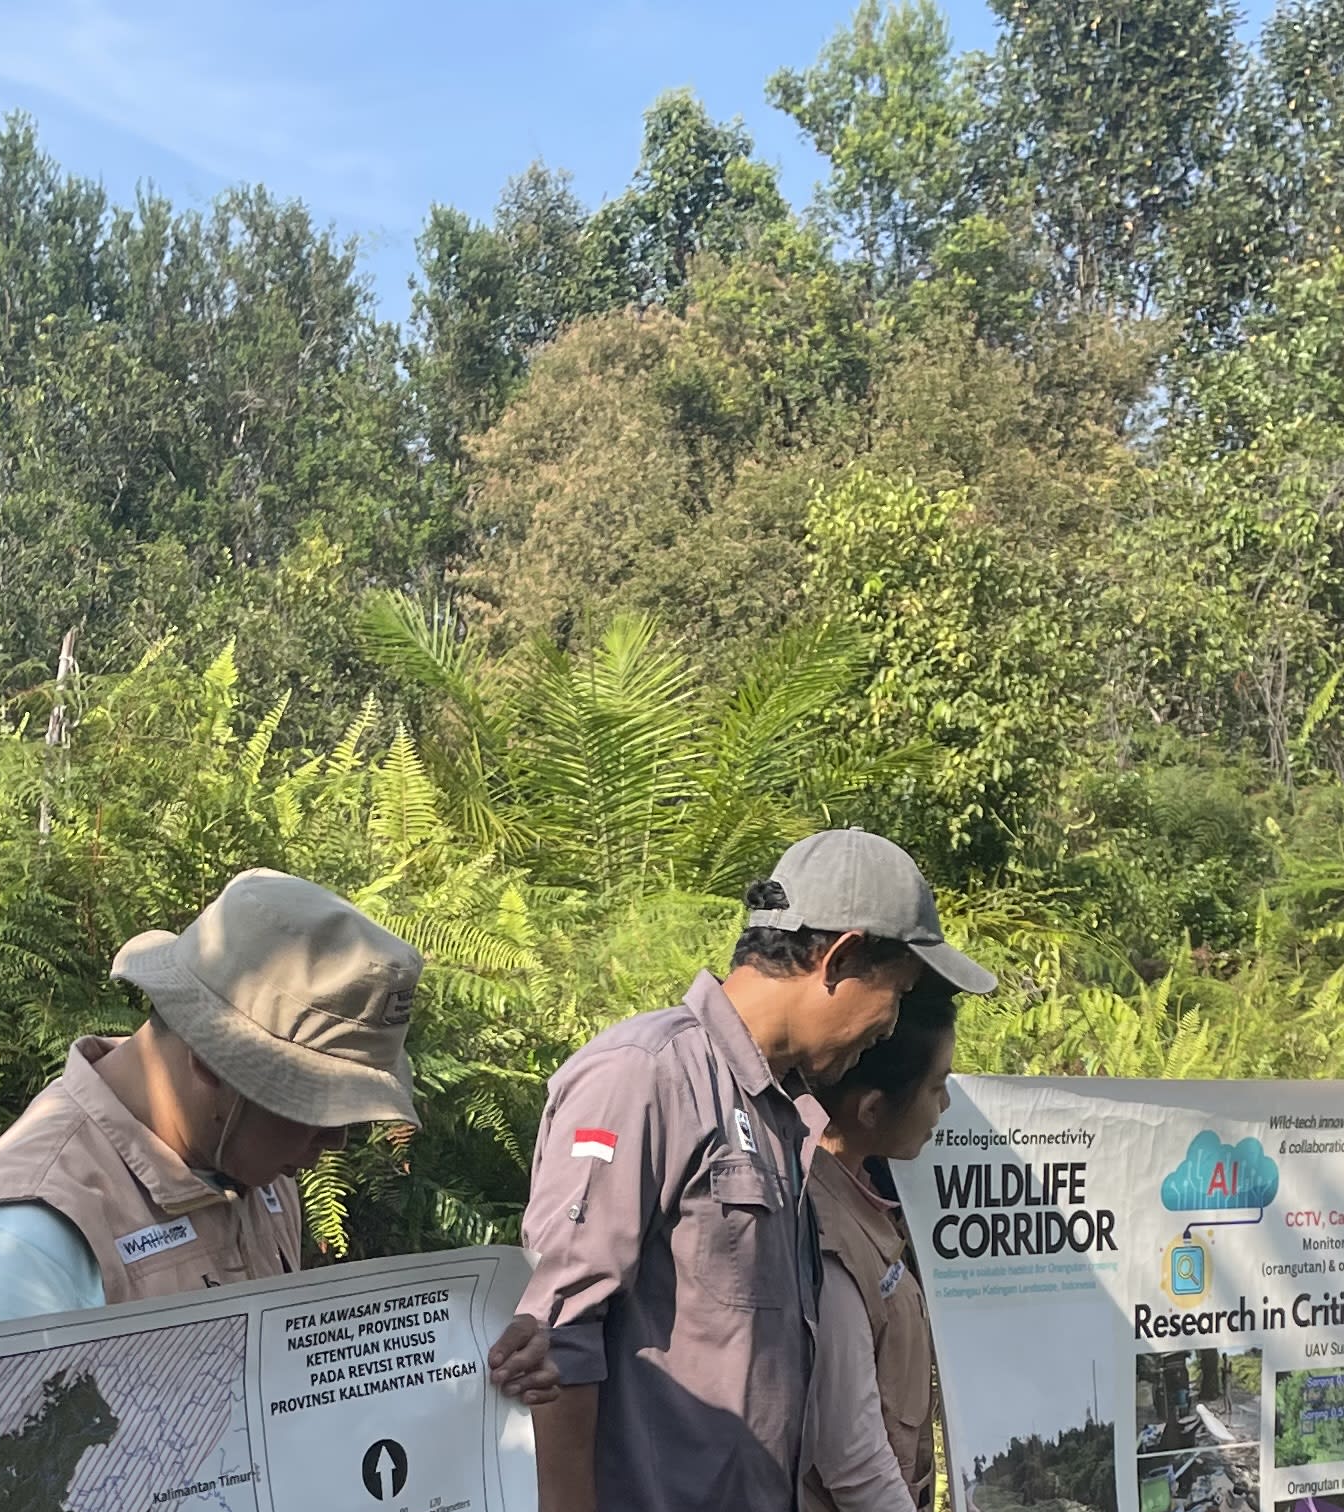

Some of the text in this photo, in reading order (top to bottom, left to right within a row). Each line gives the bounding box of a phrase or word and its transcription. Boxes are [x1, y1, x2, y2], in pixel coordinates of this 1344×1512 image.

[934, 1128, 1096, 1150] #EcologicalConnectivity
[1269, 1115, 1316, 1130] Wild-tech
[1279, 1141, 1287, 1155] &
[933, 1162, 1087, 1209] WILDLIFE
[1207, 1160, 1240, 1196] AI
[932, 1210, 1118, 1259] CORRIDOR
[1285, 1210, 1325, 1229] CCTV,
[1262, 1259, 1326, 1278] (orangutan)
[1329, 1259, 1336, 1272] &
[286, 1289, 449, 1332] PETA KAWASAN STRATEGIS
[1135, 1296, 1256, 1340] Research
[1262, 1296, 1285, 1330] in
[287, 1308, 449, 1351] NASIONAL, PROVINSI DAN
[306, 1330, 436, 1367] KETENTUAN KHUSUS
[1305, 1343, 1329, 1358] UAV
[310, 1350, 435, 1386] PADA REVISI RTRW
[271, 1361, 477, 1416] PROVINSI KALIMANTAN TENGAH
[152, 1480, 216, 1504] Kalimantan
[218, 1471, 256, 1487] Timur
[1288, 1478, 1339, 1498] Orangutan
